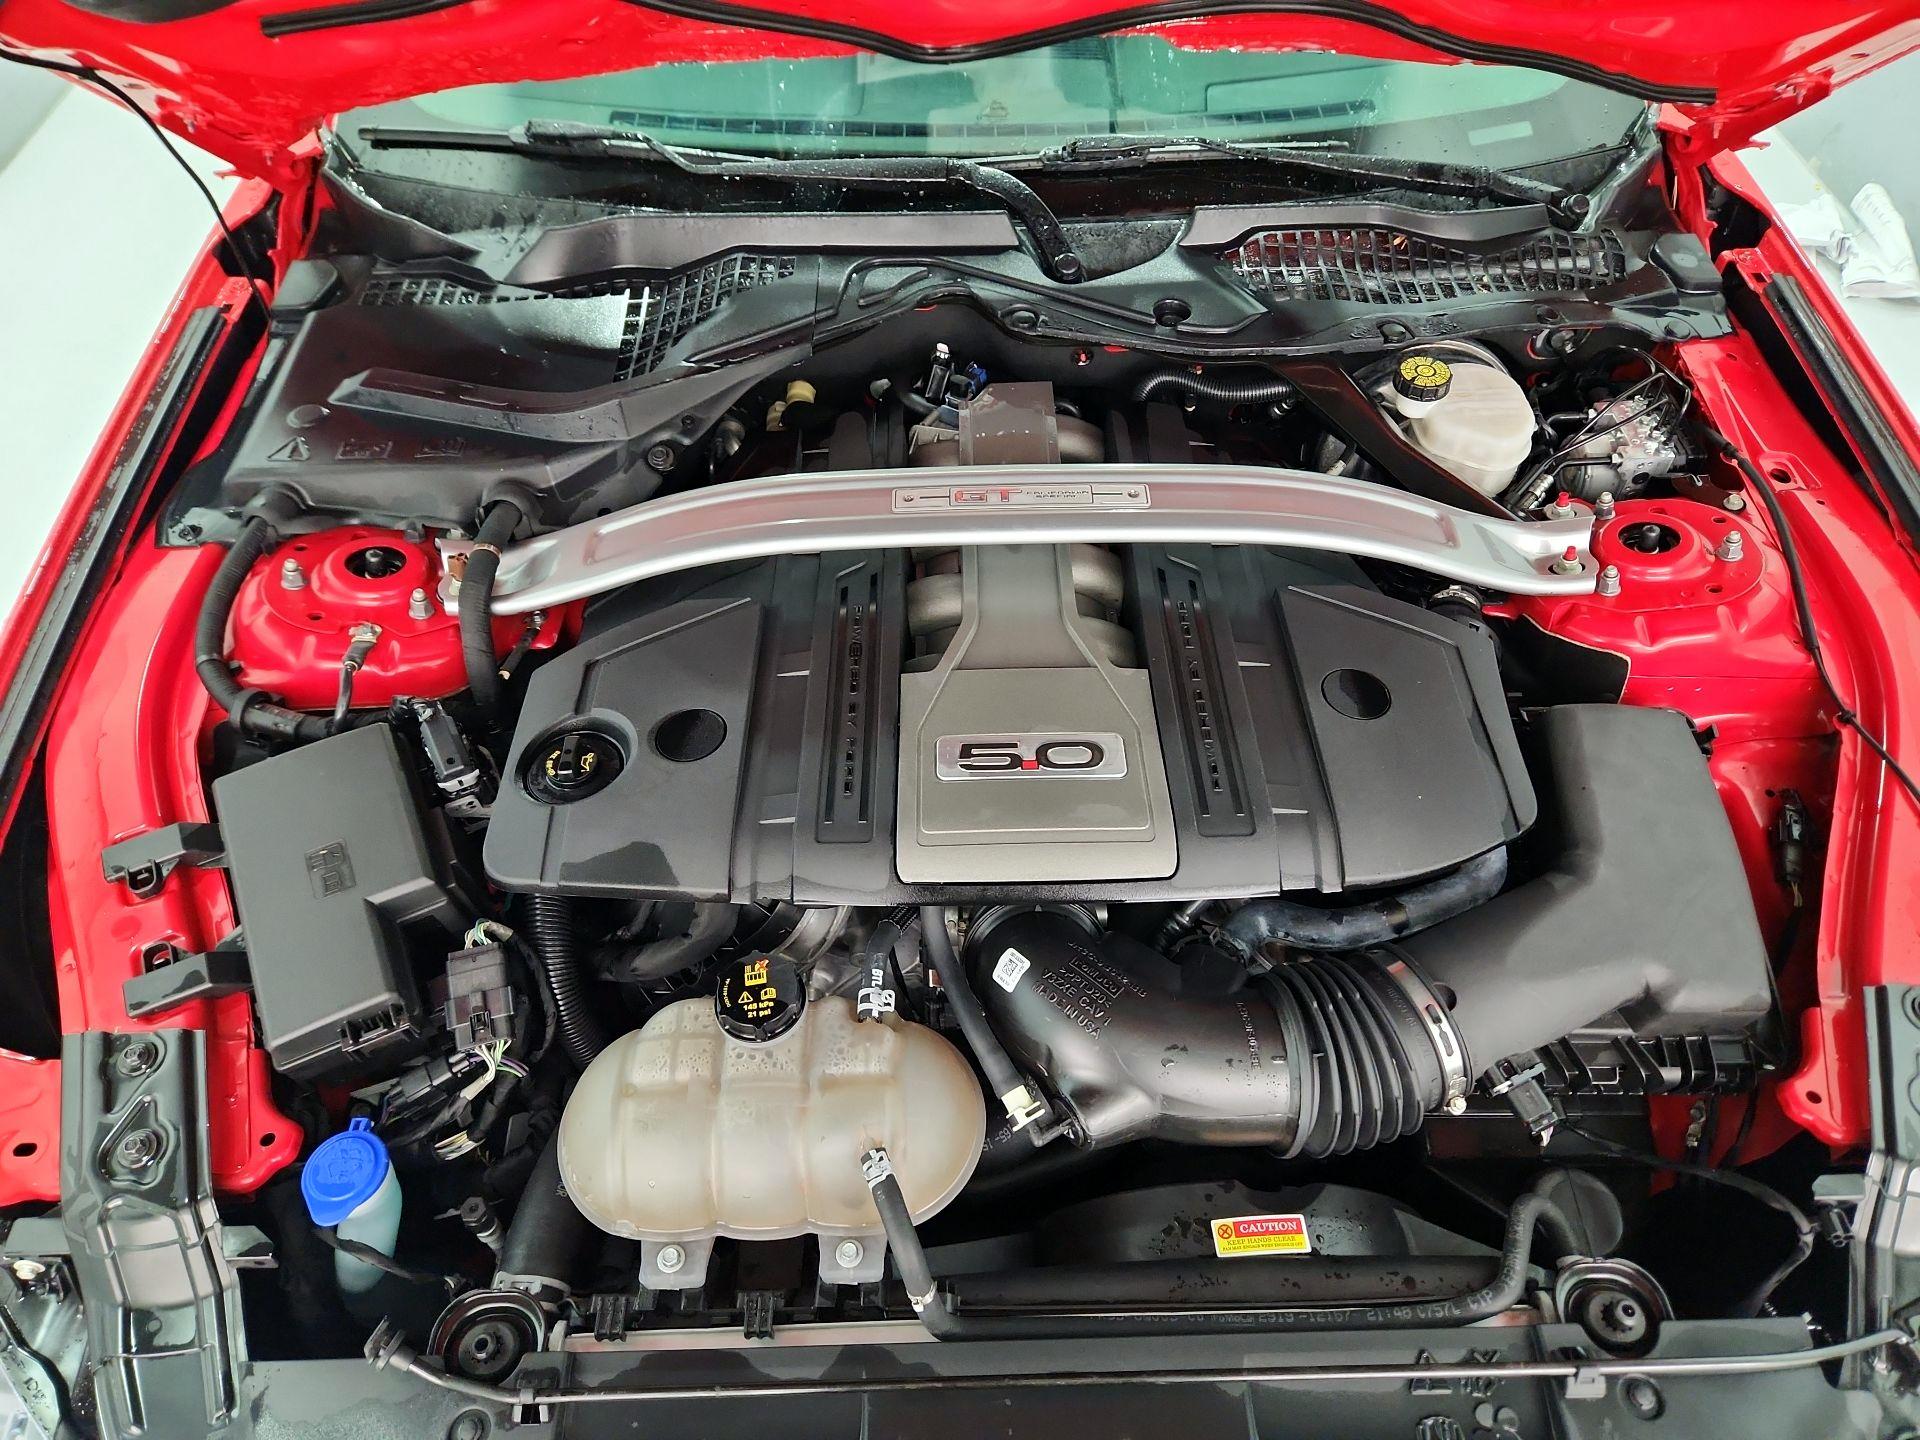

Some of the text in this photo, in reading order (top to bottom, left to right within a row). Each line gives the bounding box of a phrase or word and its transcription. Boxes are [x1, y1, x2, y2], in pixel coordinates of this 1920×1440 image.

[954, 487, 1023, 503] GT
[957, 741, 1104, 771] 5.0
[747, 1008, 772, 1019] 21 psi
[1031, 981, 1101, 1040] MADE IN USA
[1078, 996, 1105, 1018] CAV
[1239, 1221, 1297, 1234] CAUTION
[1227, 1235, 1296, 1246] KEEP HANDS CLEAR
